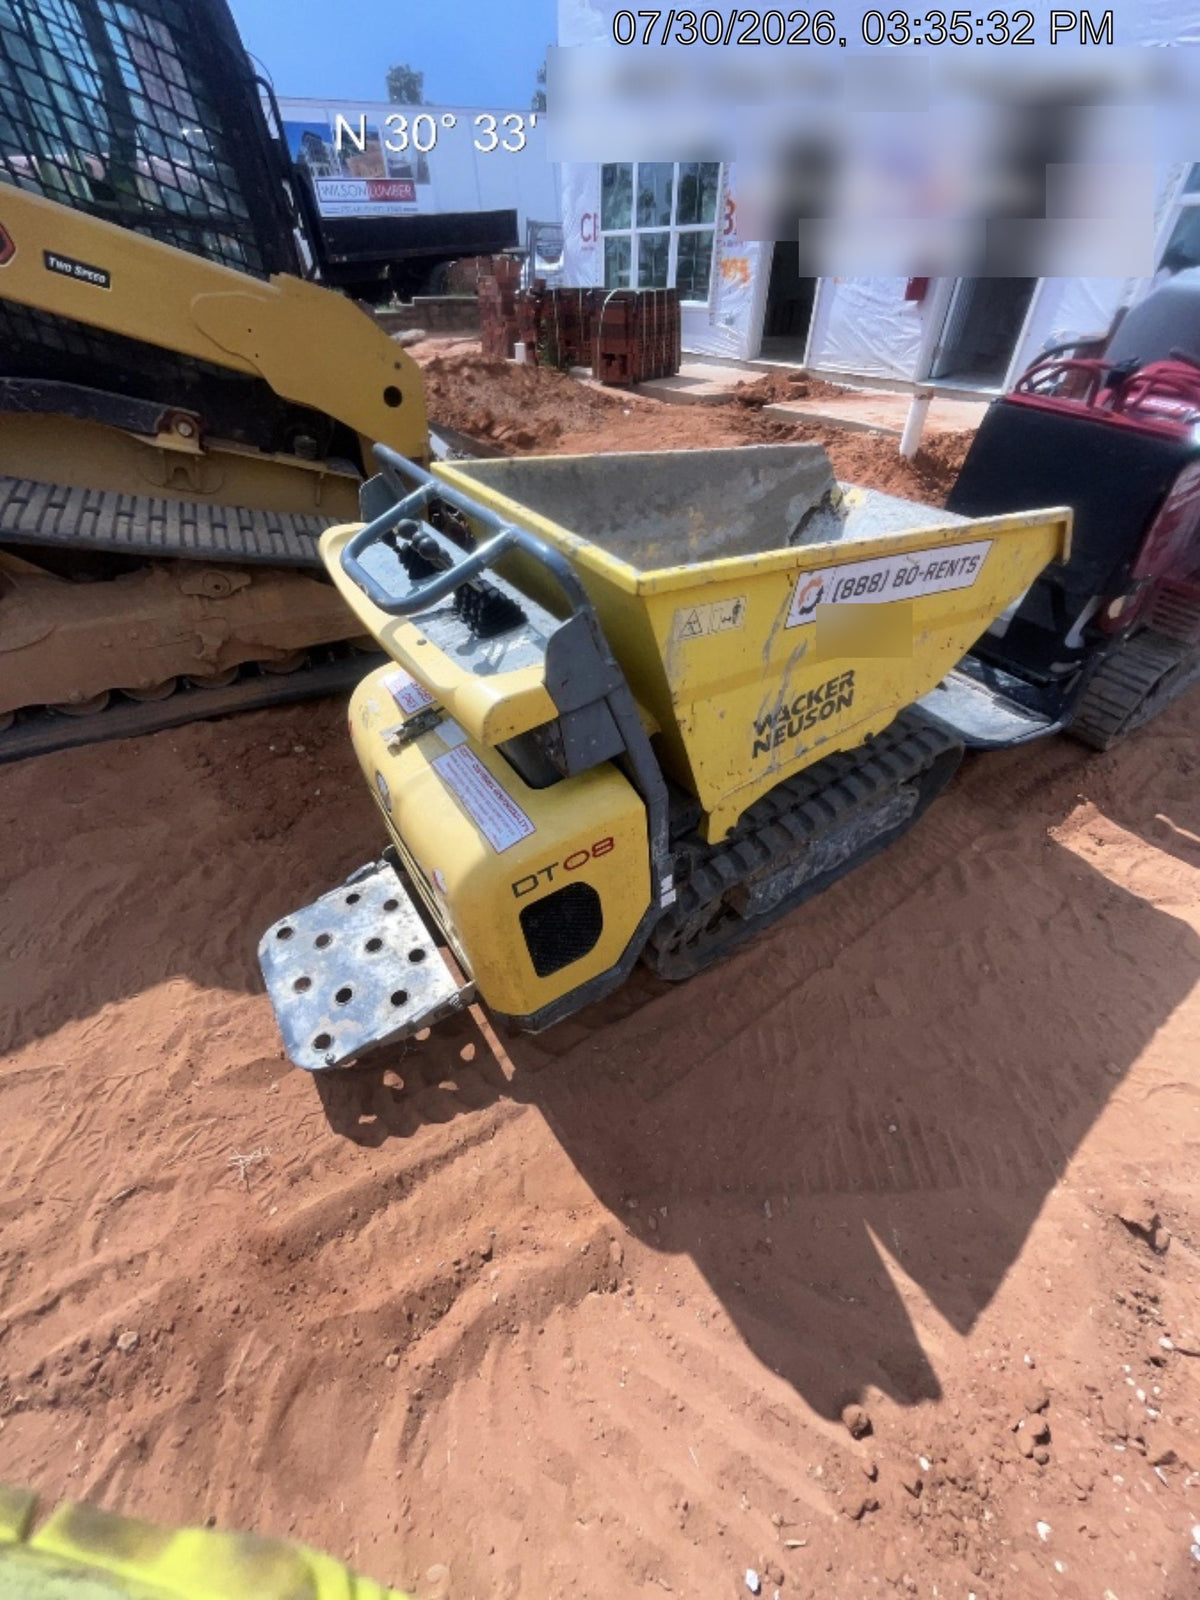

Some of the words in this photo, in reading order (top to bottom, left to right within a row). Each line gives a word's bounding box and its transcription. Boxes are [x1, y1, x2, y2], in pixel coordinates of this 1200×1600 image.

[832, 569, 890, 603] (888)
[892, 555, 981, 588] BO-RENTS
[752, 688, 854, 759] NEUSON
[753, 669, 855, 736] WACKER
[512, 837, 614, 898] DT08
